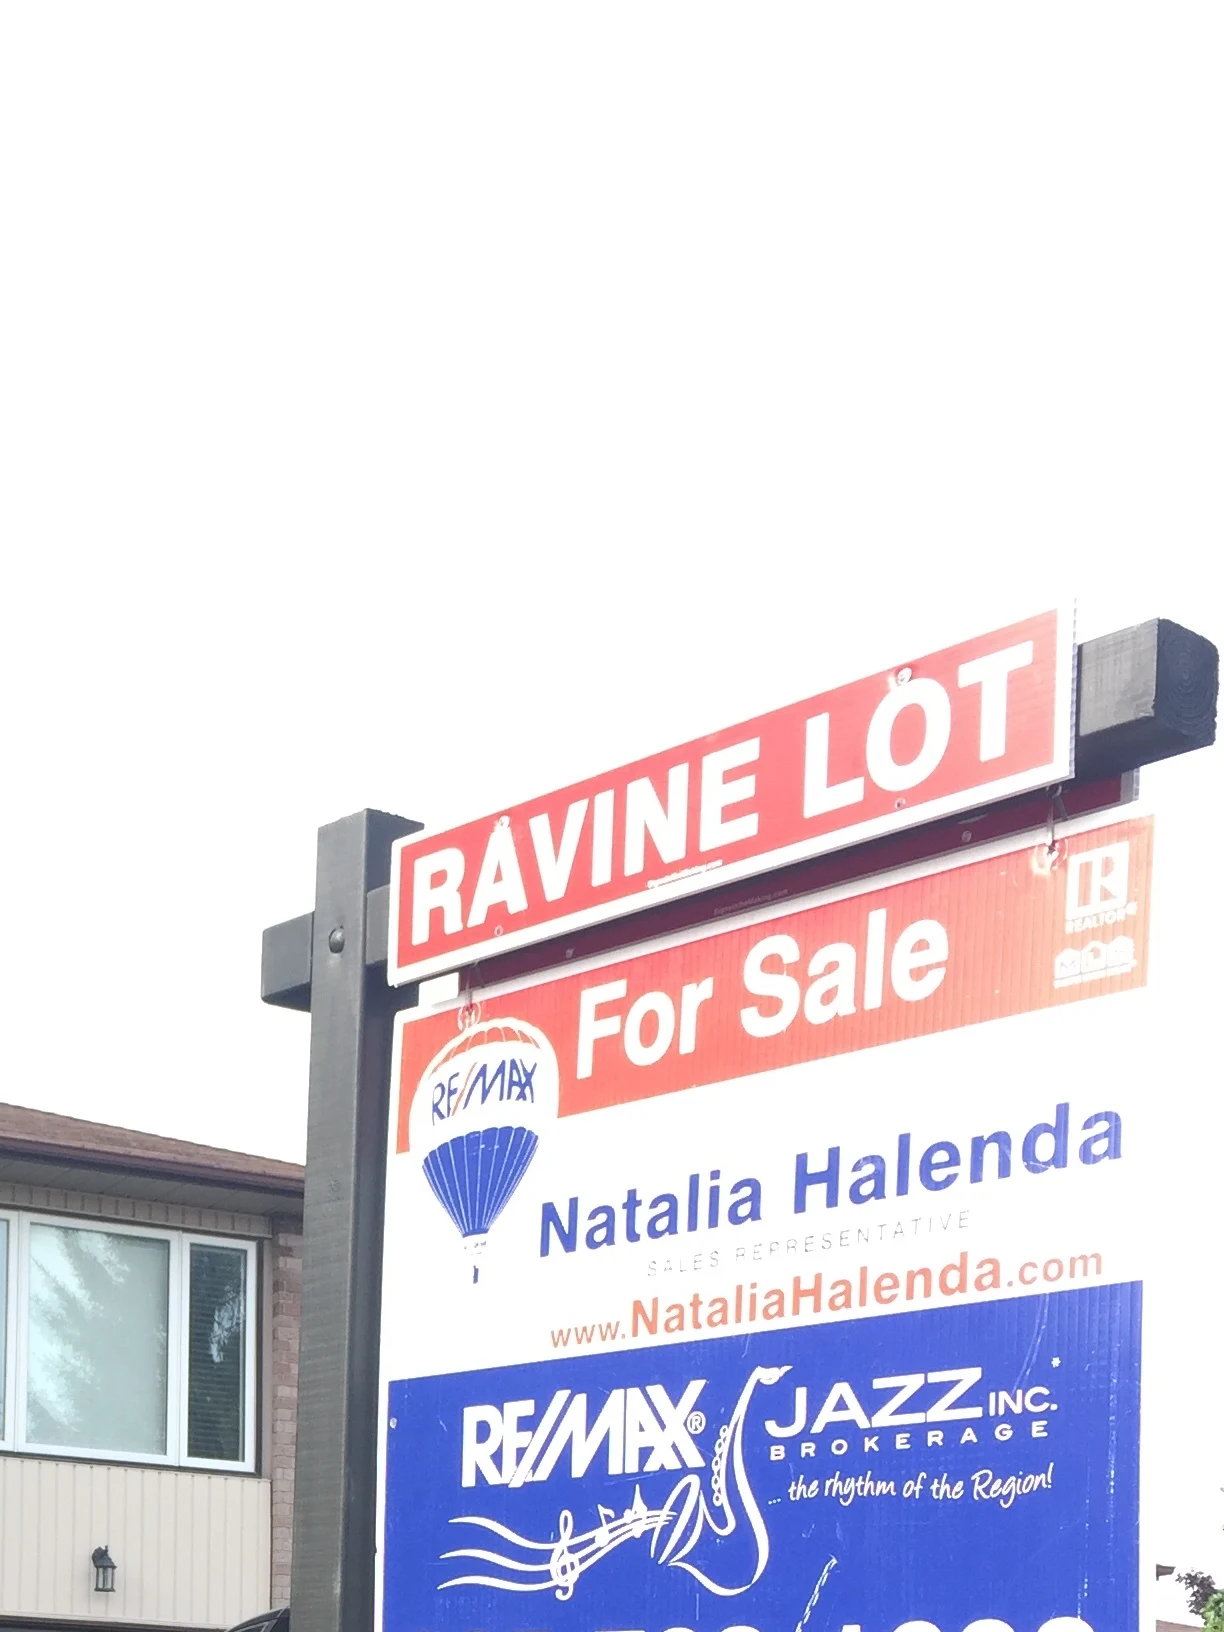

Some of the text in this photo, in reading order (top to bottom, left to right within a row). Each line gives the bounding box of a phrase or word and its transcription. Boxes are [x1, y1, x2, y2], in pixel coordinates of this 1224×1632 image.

[412, 640, 1034, 947] RAVINE LOT
[577, 908, 950, 1080] For Sale
[432, 1058, 538, 1126] RE/MAX
[539, 1102, 1124, 1258] Natalia Halenda
[647, 1209, 971, 1277] SALES REPRESENTATIVE
[550, 1252, 1104, 1348] www.NataliaHalenda.com
[765, 1367, 1059, 1438] JAZZ INC.
[770, 1420, 1049, 1461] BROKERAGE
[788, 1475, 820, 1501] the
[824, 1471, 897, 1507] rhythm
[903, 1472, 928, 1500] of
[930, 1473, 965, 1500] the
[971, 1462, 1056, 1509] Region!
